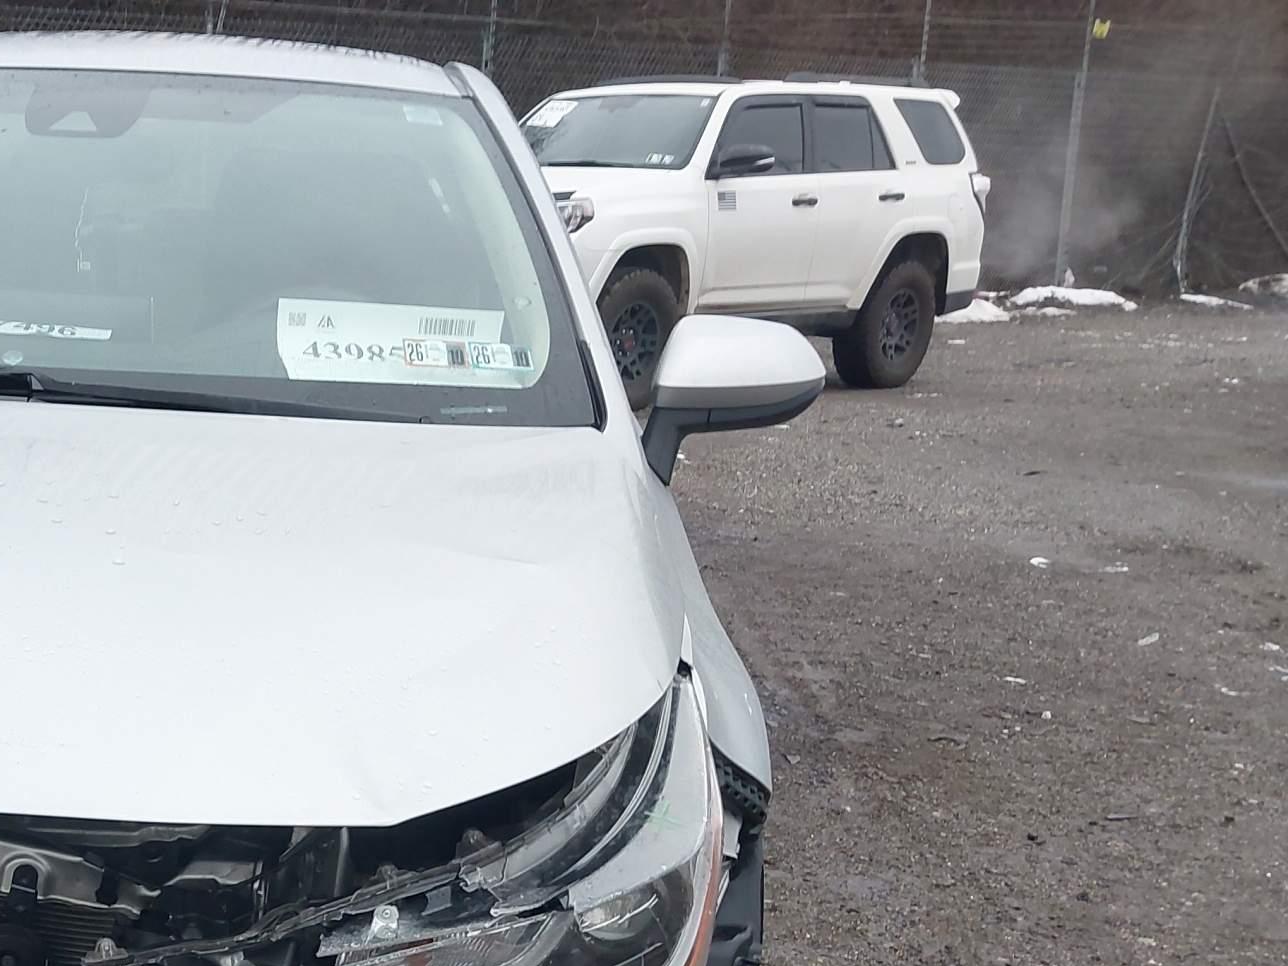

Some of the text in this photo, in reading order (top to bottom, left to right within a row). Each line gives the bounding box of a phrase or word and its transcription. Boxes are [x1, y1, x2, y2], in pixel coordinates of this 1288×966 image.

[407, 343, 424, 362] 26
[448, 349, 465, 365] 10
[473, 345, 491, 364] 26
